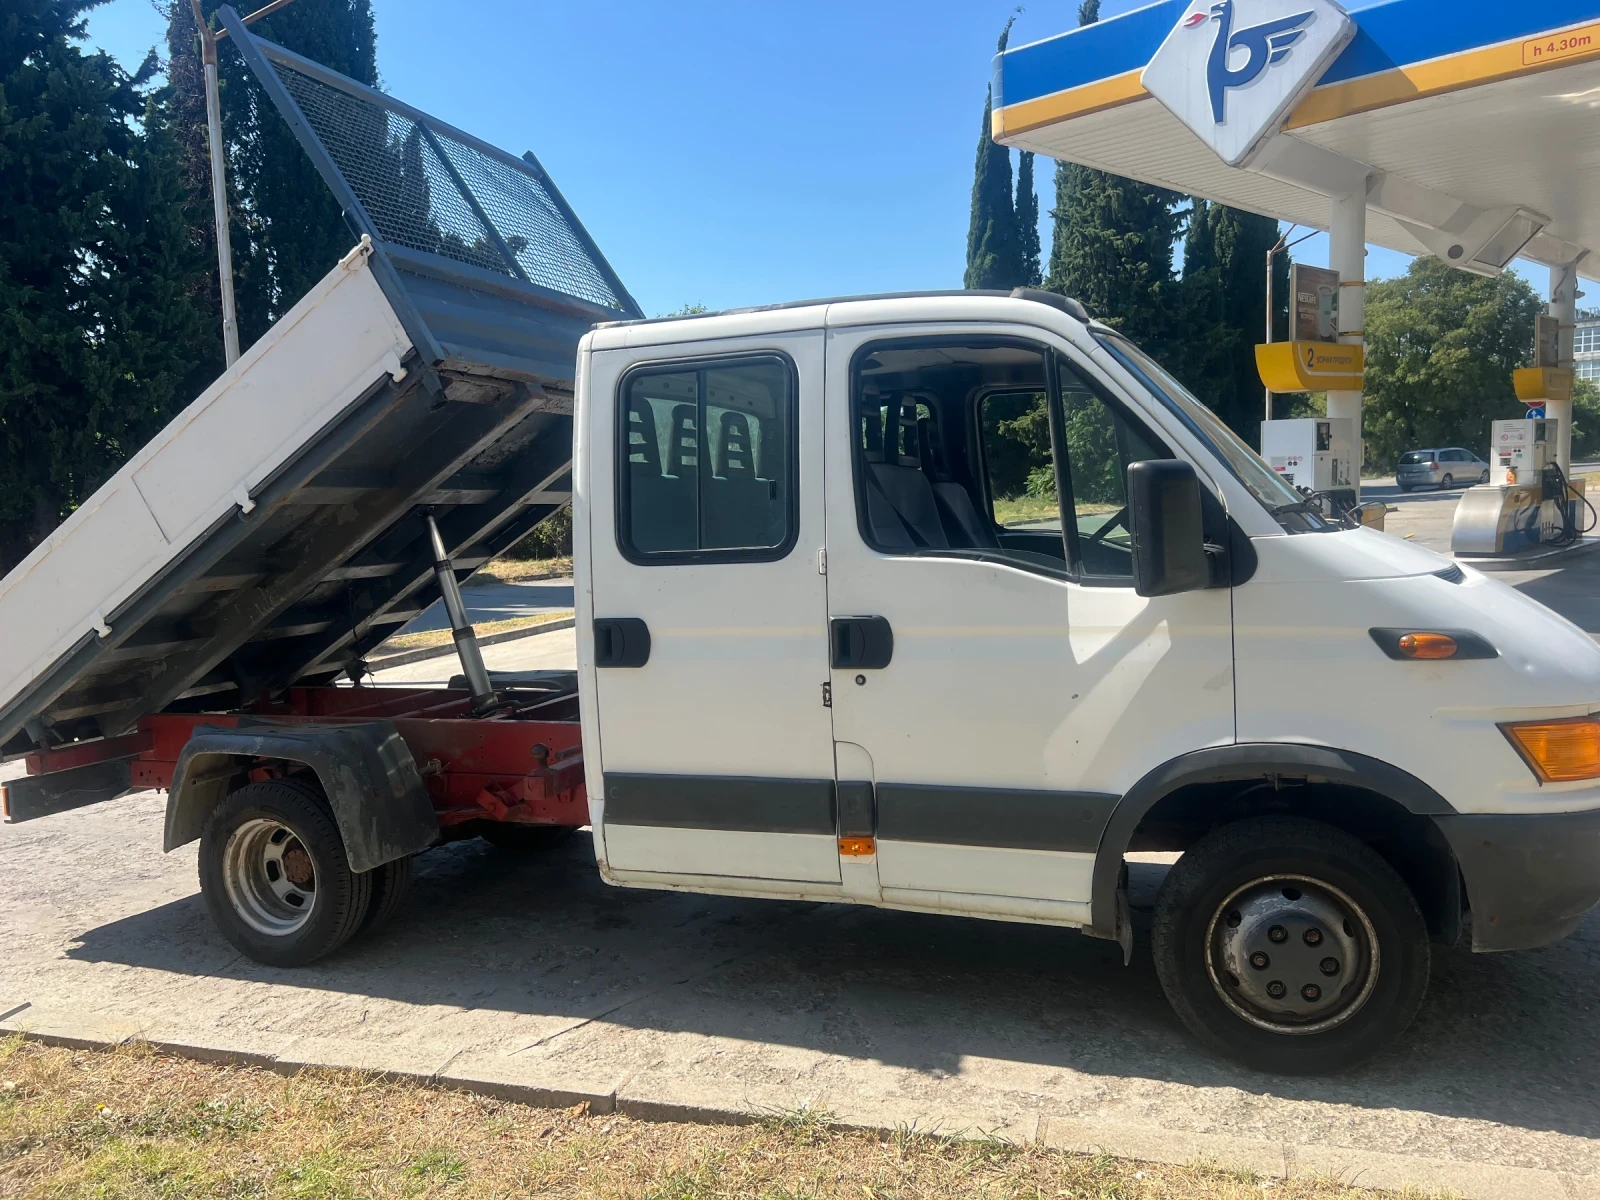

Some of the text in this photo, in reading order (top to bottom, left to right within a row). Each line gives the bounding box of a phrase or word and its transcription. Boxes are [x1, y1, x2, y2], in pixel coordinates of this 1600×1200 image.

[1533, 36, 1591, 56] h 4.30m
[1307, 348, 1314, 367] 2
